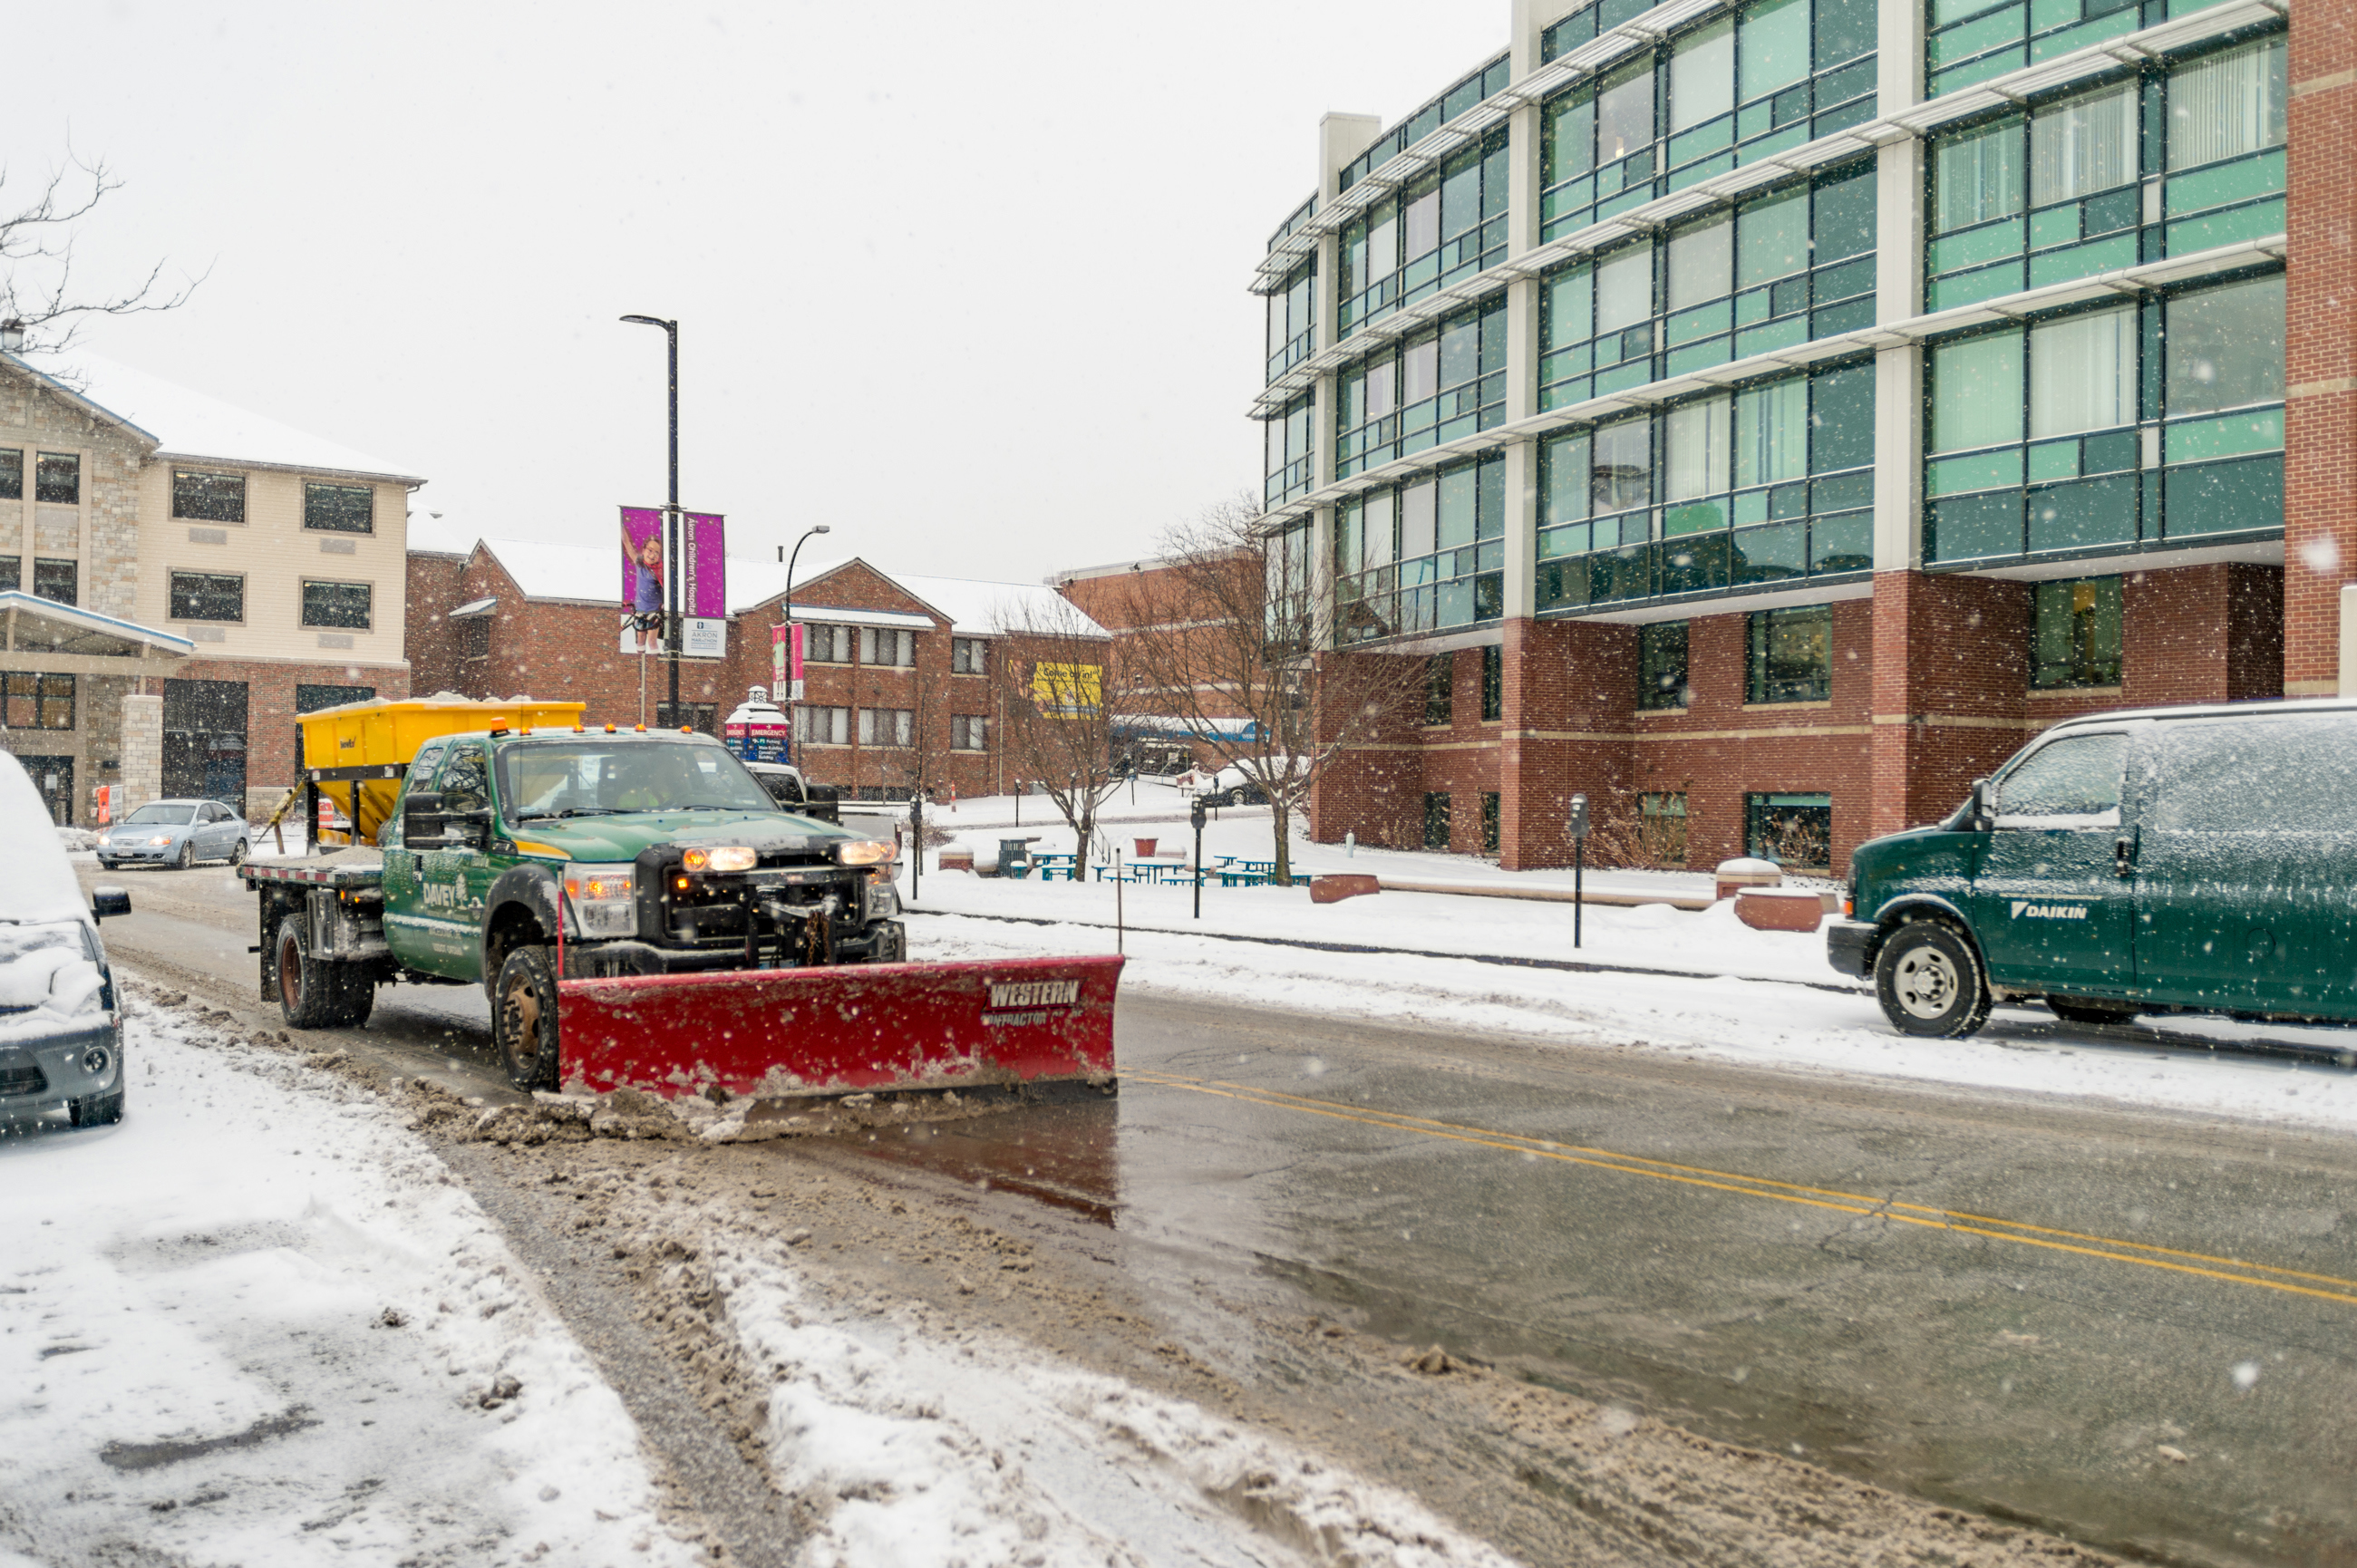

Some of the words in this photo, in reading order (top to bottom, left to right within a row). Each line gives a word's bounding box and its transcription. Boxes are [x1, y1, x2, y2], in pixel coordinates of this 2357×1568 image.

[687, 517, 695, 540] Akron
[688, 542, 696, 581] Children's
[687, 583, 697, 615] Hospital
[751, 729, 786, 737] EMERGENCY
[422, 882, 456, 907] DAVEY
[2025, 906, 2088, 919] DAIKIN
[990, 980, 1080, 1008] WESTERN
